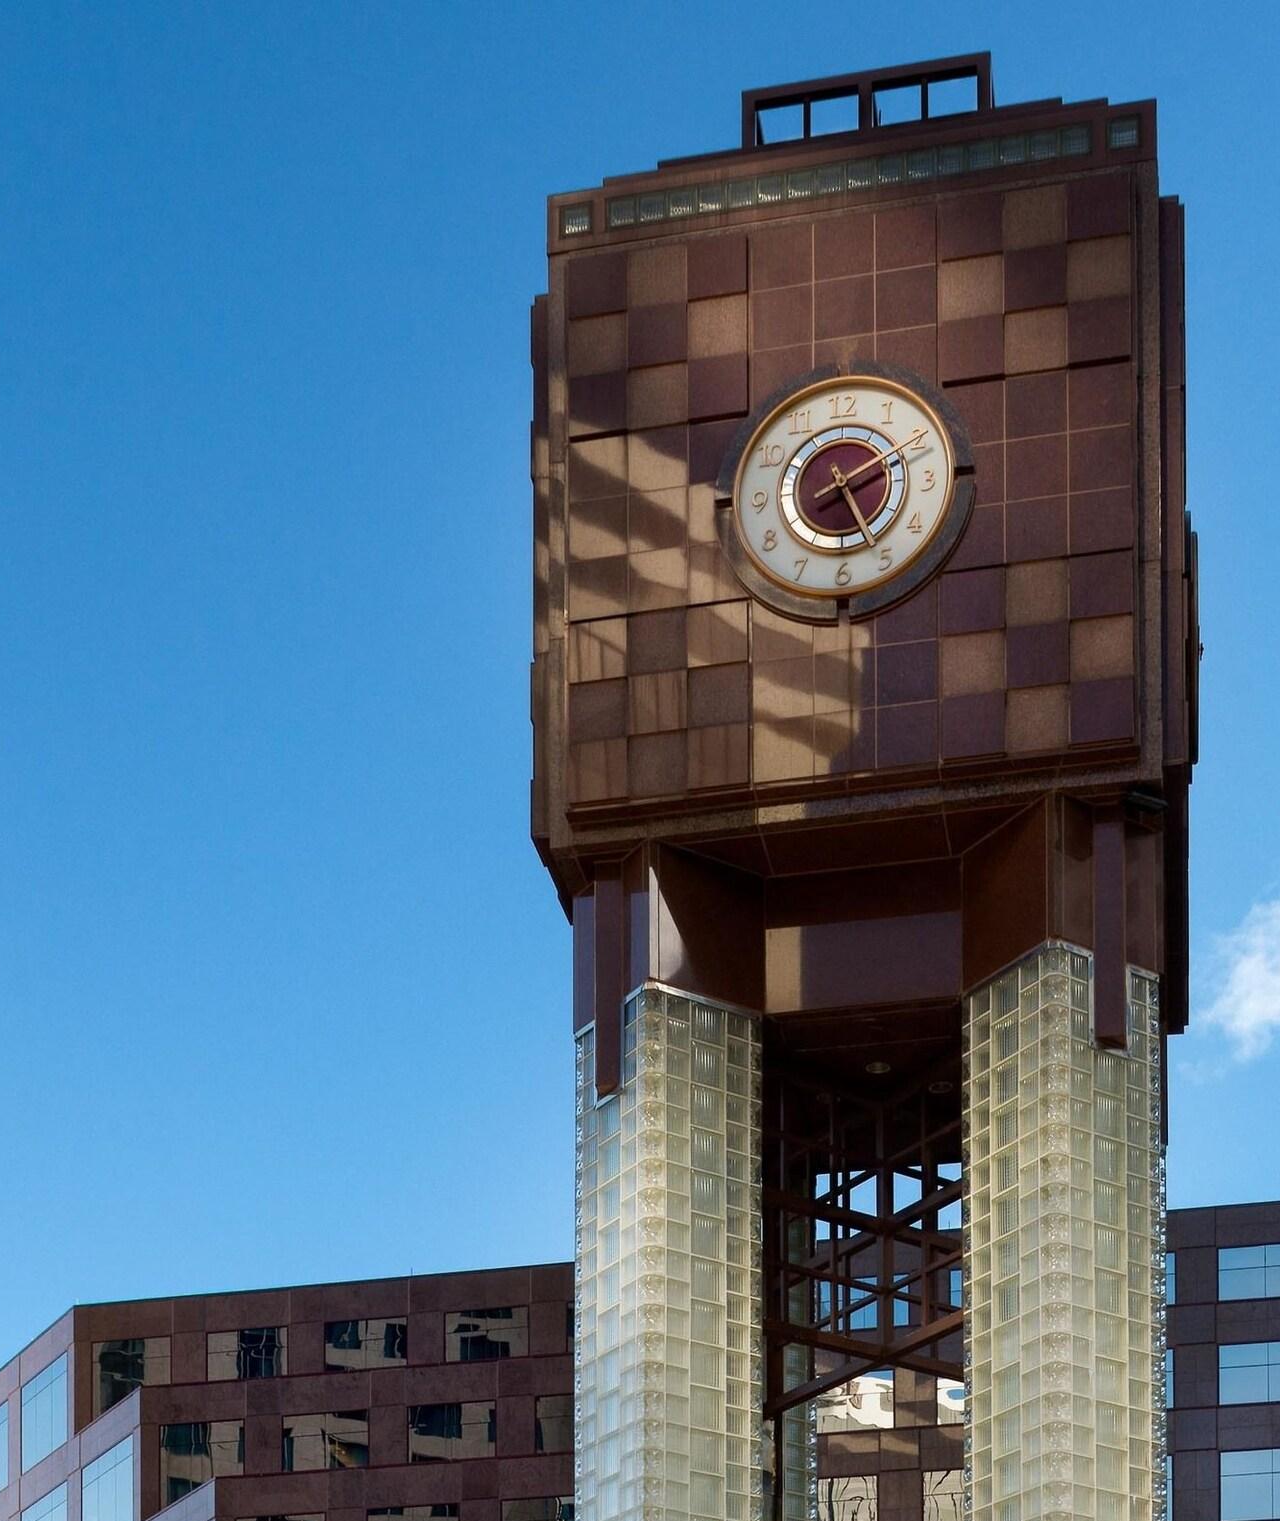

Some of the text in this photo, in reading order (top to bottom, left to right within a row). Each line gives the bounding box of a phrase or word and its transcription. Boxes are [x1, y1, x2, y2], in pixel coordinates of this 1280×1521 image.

[828, 395, 857, 419] 12
[880, 400, 893, 424] 1
[787, 410, 813, 435] 11
[758, 444, 786, 468] 10
[920, 468, 936, 492] 3
[752, 490, 768, 514] 9
[906, 511, 923, 533] 4
[762, 528, 777, 552] 8
[794, 557, 809, 582] 7
[878, 547, 893, 571] 5
[834, 561, 852, 586] 6
